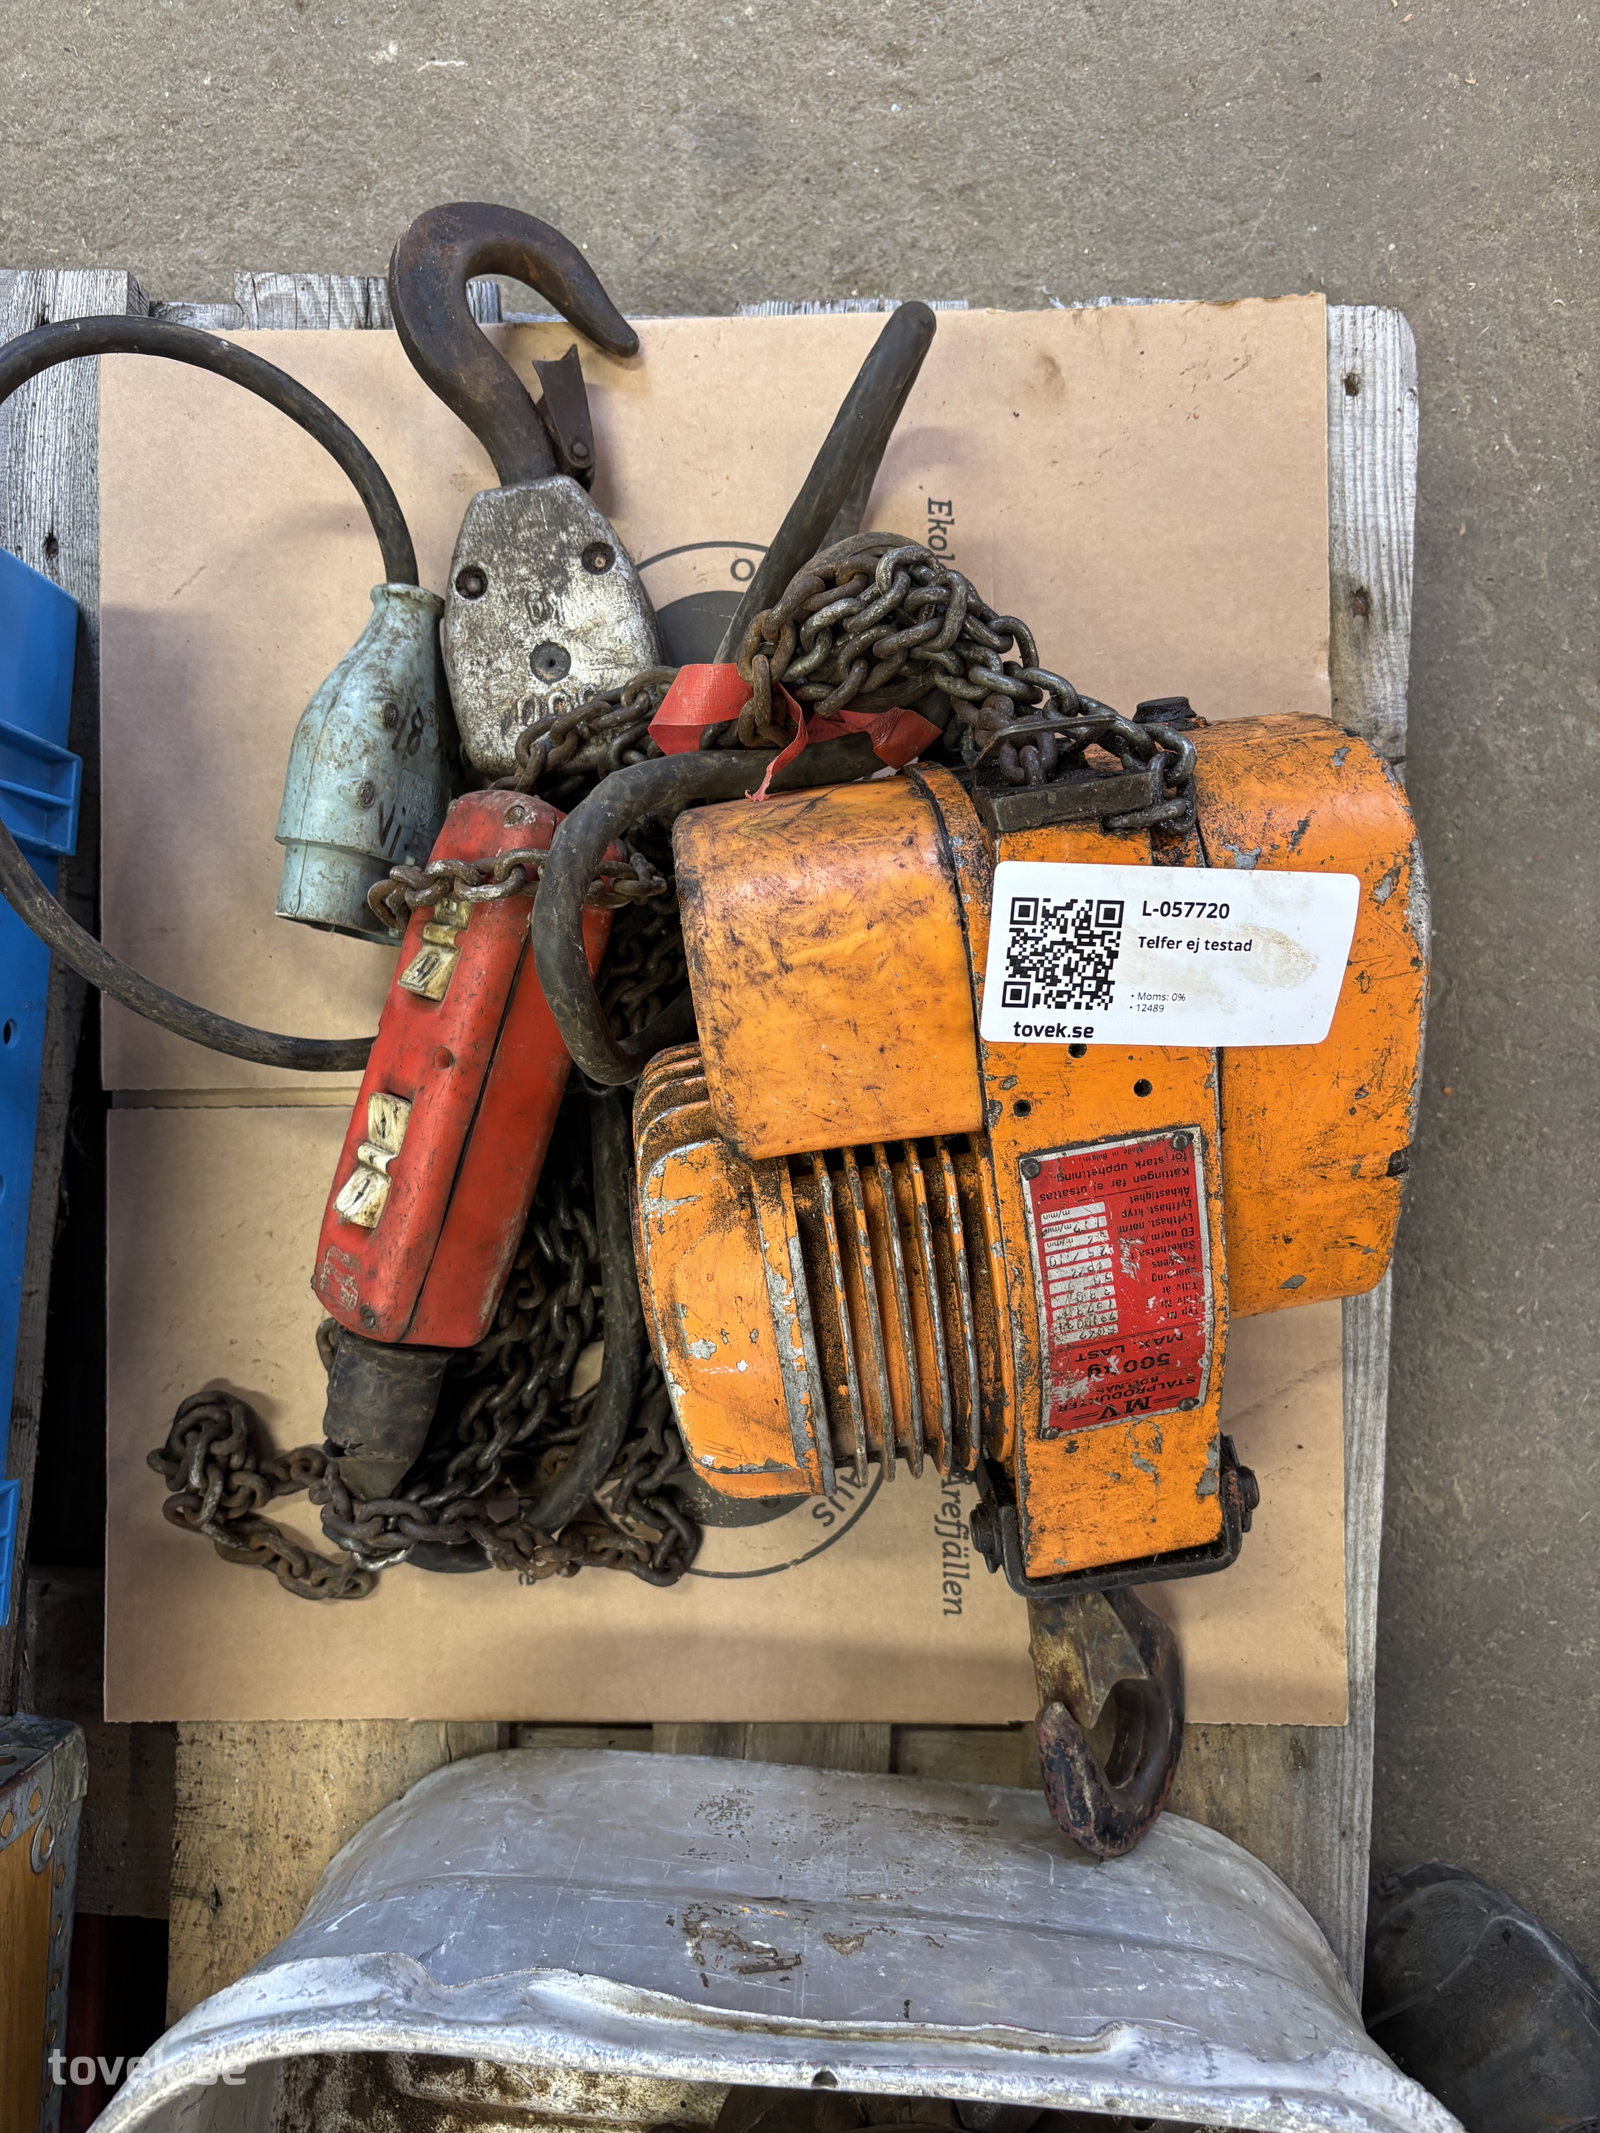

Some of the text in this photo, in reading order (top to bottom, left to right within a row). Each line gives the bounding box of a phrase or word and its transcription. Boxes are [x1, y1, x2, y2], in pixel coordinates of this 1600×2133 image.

[1142, 900, 1230, 919] L-057720
[1138, 936, 1252, 953] Telfer ej testad
[1137, 992, 1186, 1002] Moms: 0%
[1136, 1003, 1165, 1013] 12489
[1013, 1021, 1094, 1039] tovek.se
[1134, 1156, 1164, 1168] stark
[1042, 1210, 1070, 1220] m/min
[1151, 1230, 1177, 1241] norm
[1181, 1227, 1194, 1237] ED
[1133, 1333, 1184, 1349] MAX.
[1074, 1345, 1125, 1362] LAST
[1123, 1352, 1170, 1374] 500
[1096, 1396, 1152, 1420] MV
